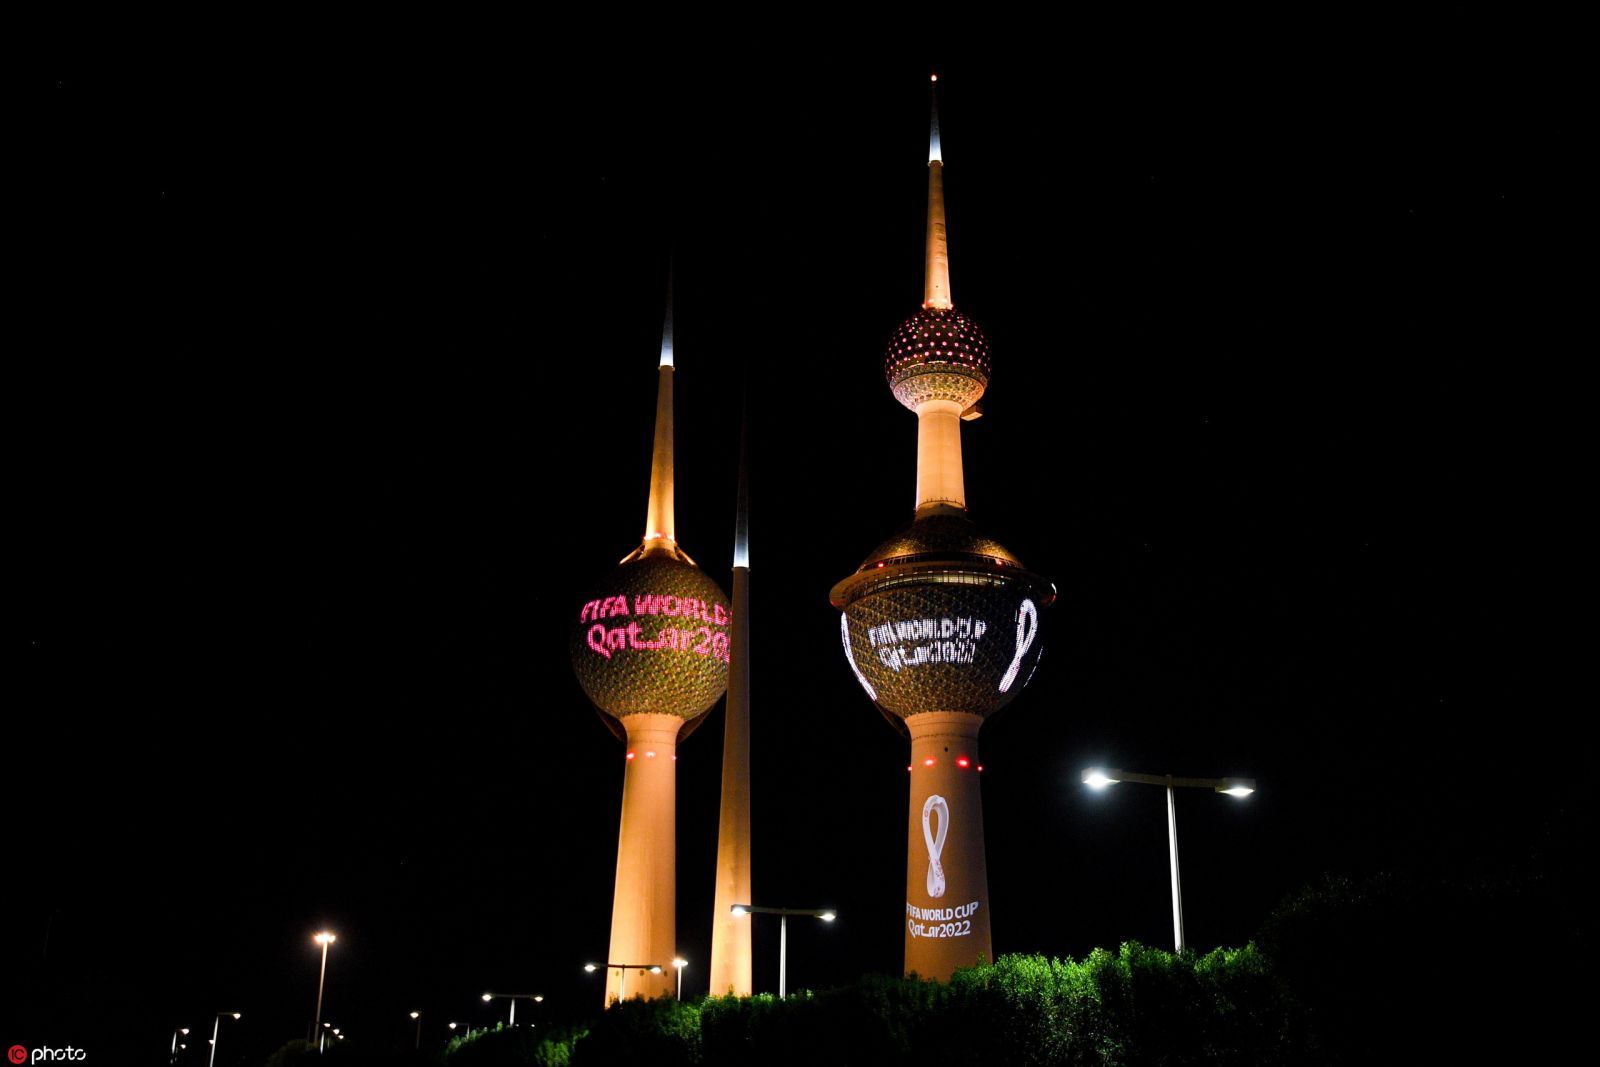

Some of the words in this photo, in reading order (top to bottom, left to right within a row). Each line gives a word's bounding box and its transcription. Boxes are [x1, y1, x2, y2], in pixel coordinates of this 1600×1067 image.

[580, 594, 629, 623] FIFA
[635, 594, 728, 625] WORLD
[906, 901, 921, 919] FIFA
[921, 908, 954, 921] WORLD
[954, 901, 979, 918] CUP
